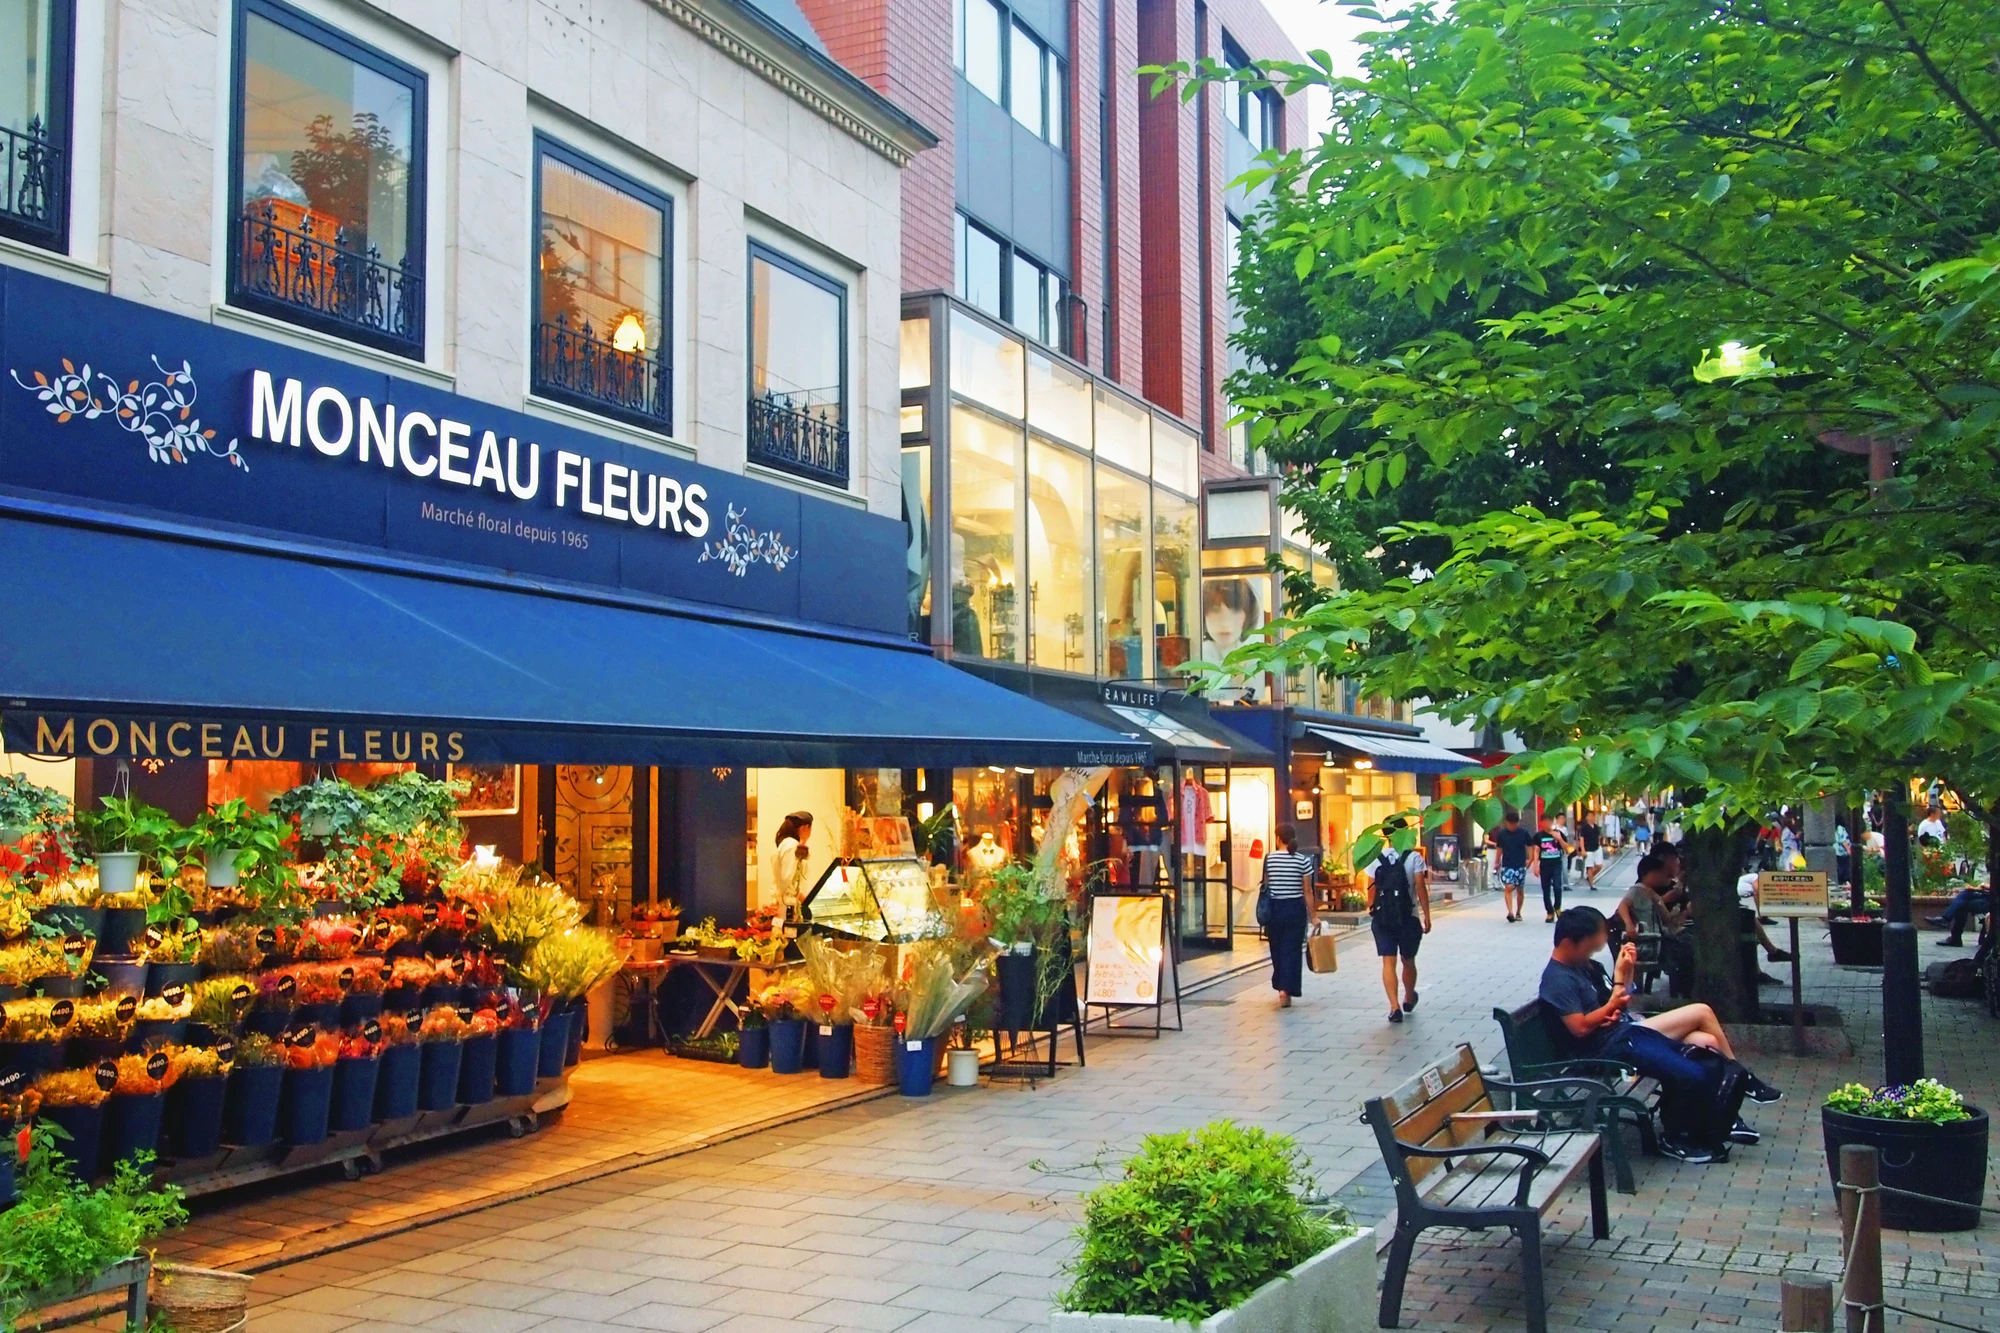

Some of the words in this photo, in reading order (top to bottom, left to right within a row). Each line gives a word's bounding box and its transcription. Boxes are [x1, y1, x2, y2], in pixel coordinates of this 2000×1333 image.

[251, 370, 540, 500] MONCEAU
[556, 450, 710, 537] FLEURS
[421, 501, 474, 528] Marché
[478, 512, 512, 535] floral
[515, 520, 557, 544] depuis
[561, 530, 589, 549] 1965
[1105, 688, 1155, 706] RAWLIFE
[37, 716, 285, 758] MONCEAU
[310, 728, 465, 761] FLEURS
